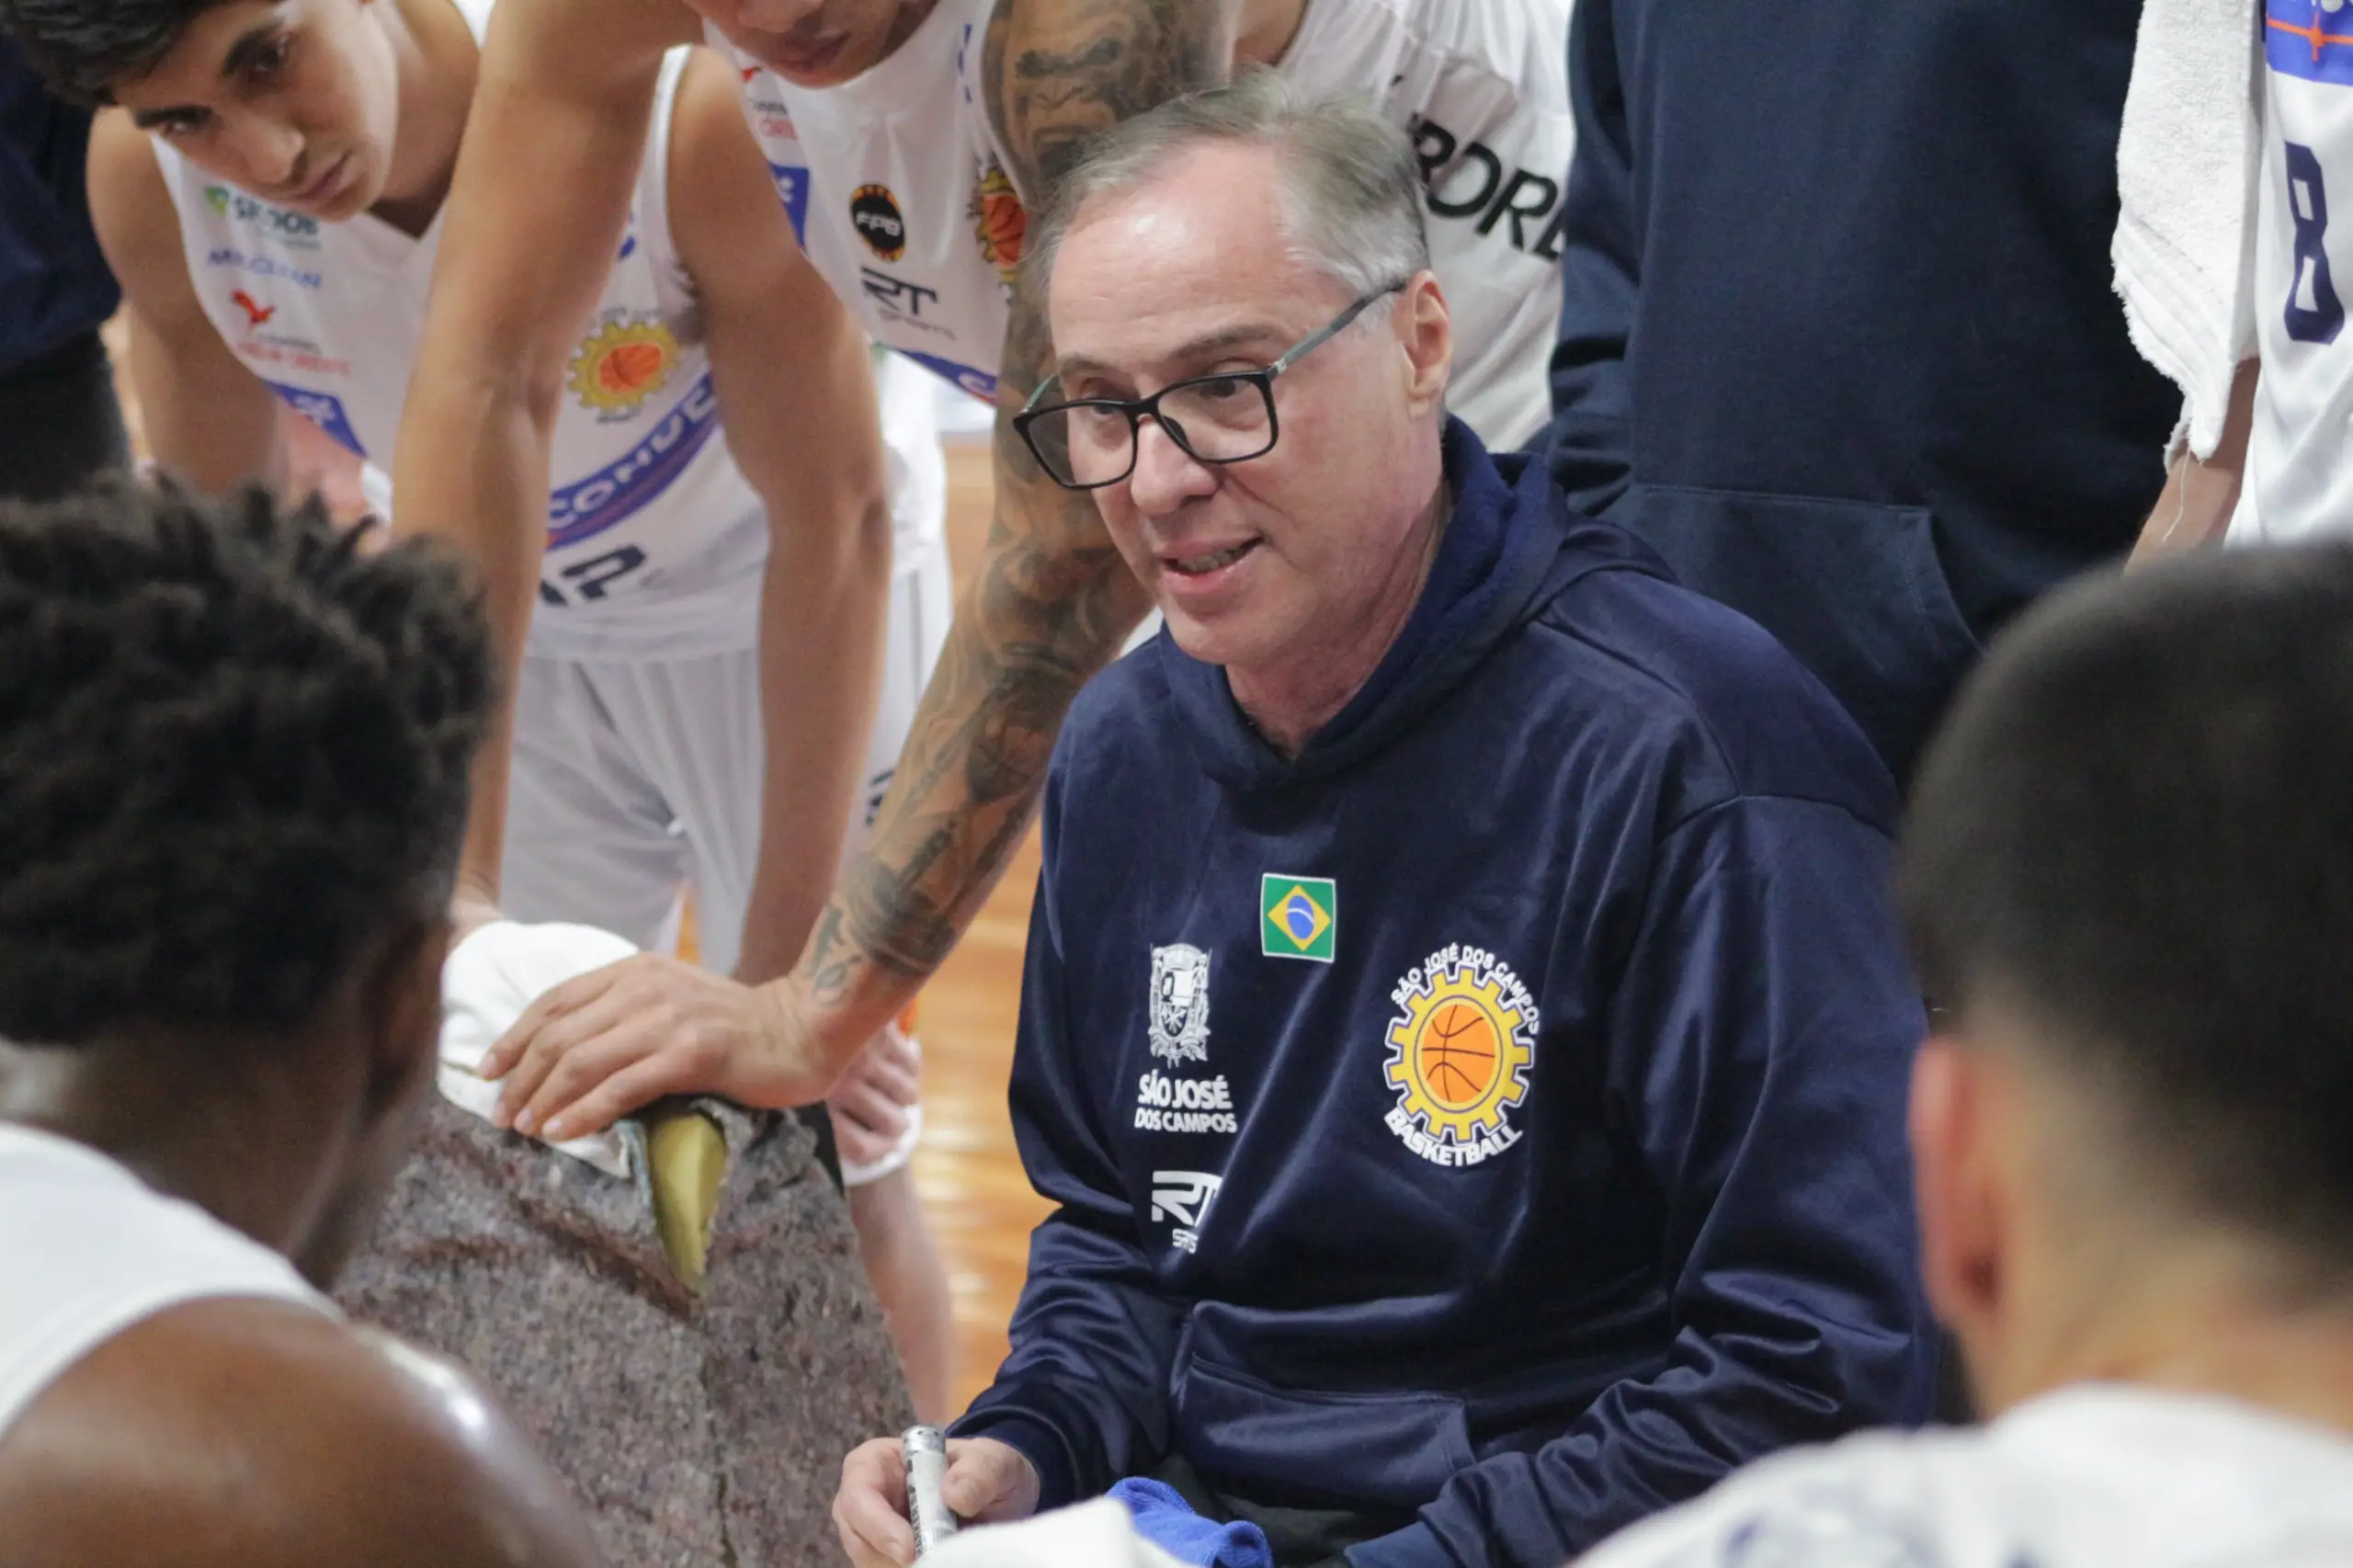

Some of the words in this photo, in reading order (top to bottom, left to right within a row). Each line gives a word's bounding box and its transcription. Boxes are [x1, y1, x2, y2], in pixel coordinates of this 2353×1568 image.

[2283, 141, 2345, 346] 8
[1390, 968, 1423, 1006] SÃO
[1424, 941, 1460, 974] JOSÉ
[1462, 944, 1496, 971] DOS
[1495, 960, 1540, 1036] CAMPOS
[1137, 1068, 1172, 1108] SÃO
[1171, 1074, 1233, 1110] JOSÉ
[1133, 1107, 1162, 1131] DOS
[1161, 1110, 1238, 1134] CAMPOS
[1383, 1108, 1524, 1168] BASKETBALL
